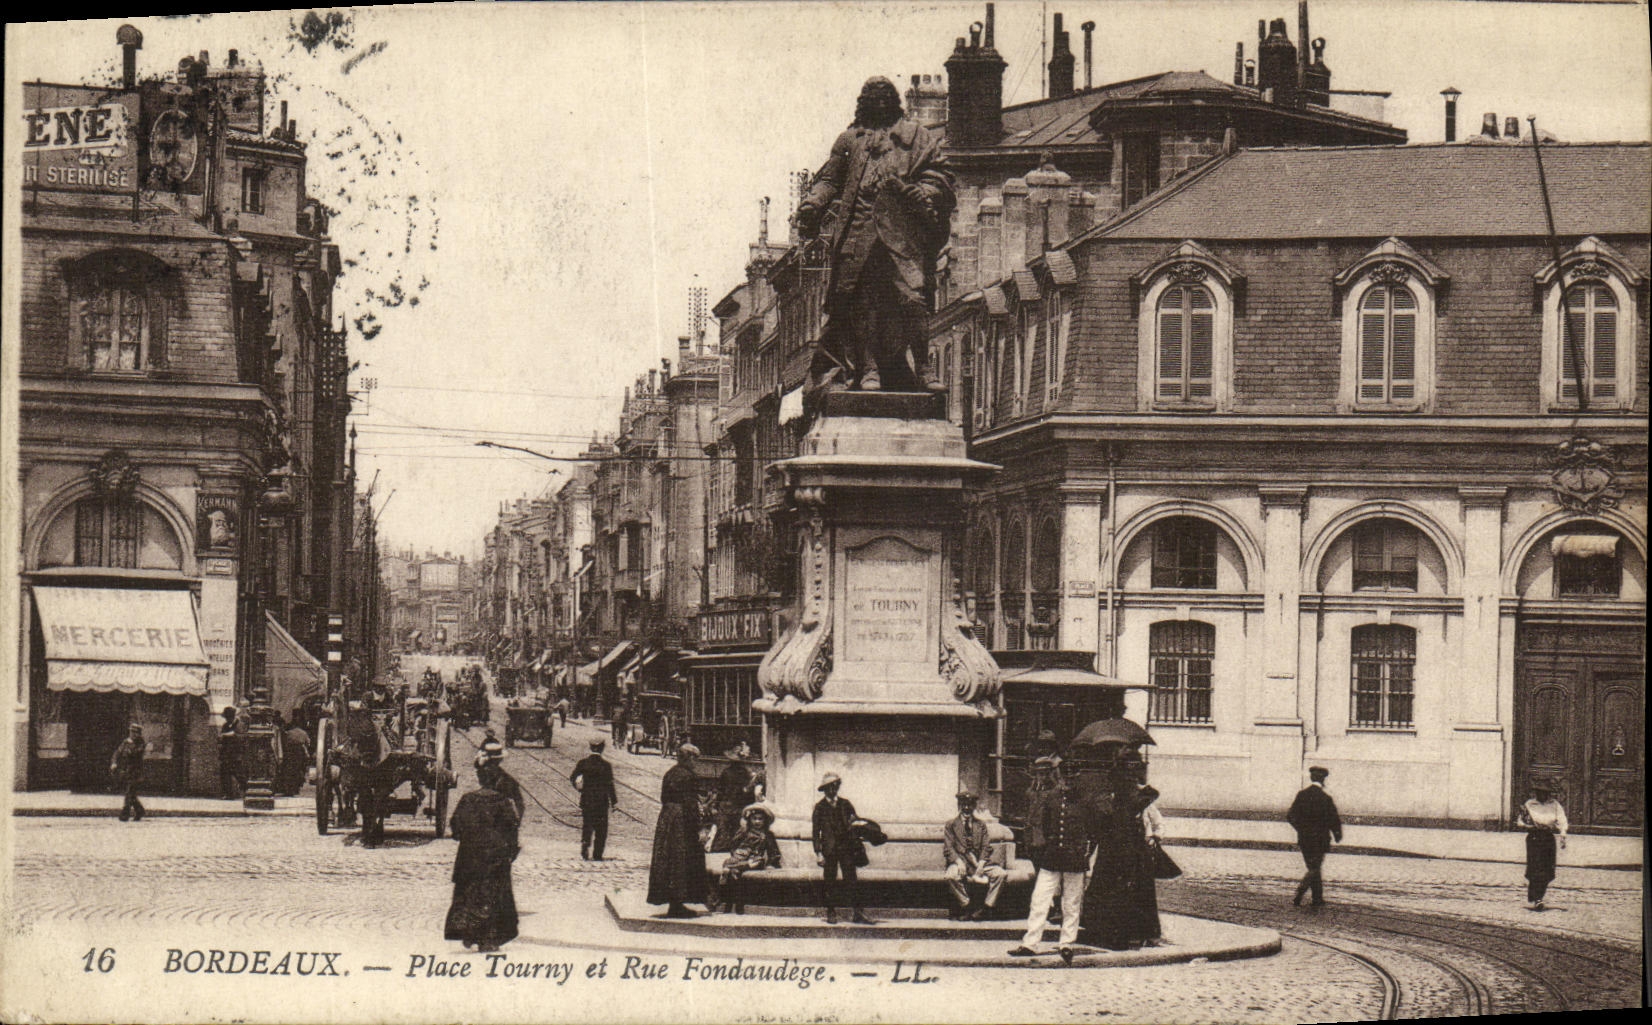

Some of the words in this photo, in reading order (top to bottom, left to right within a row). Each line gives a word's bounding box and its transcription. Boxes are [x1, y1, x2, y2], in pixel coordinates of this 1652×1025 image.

[870, 598, 919, 612] TOURNY
[51, 624, 193, 649] MERCERIE
[701, 613, 738, 641] BIJOUX
